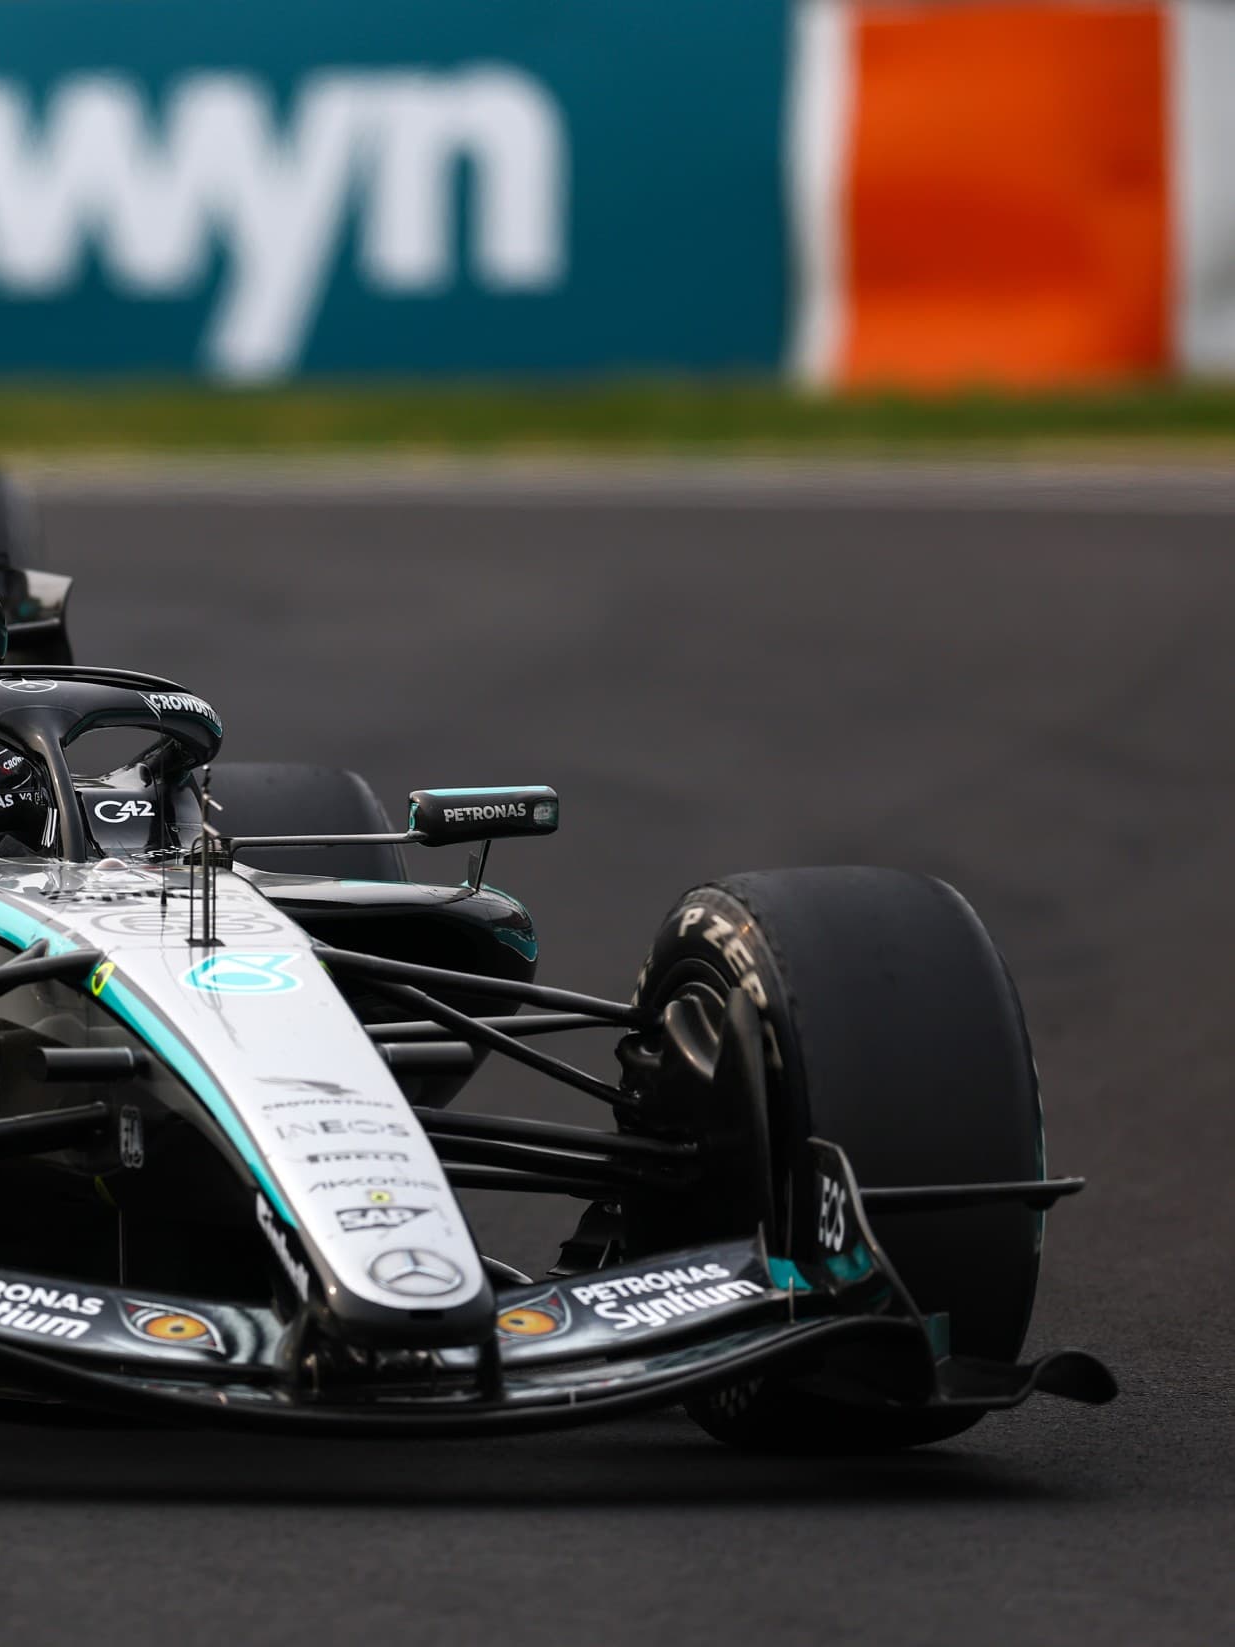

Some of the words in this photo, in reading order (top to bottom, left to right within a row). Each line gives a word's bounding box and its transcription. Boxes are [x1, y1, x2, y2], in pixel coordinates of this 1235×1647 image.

[443, 802, 527, 823] PETRONAS
[571, 1263, 731, 1306] PETRONAS
[594, 1279, 766, 1331] Syntium
